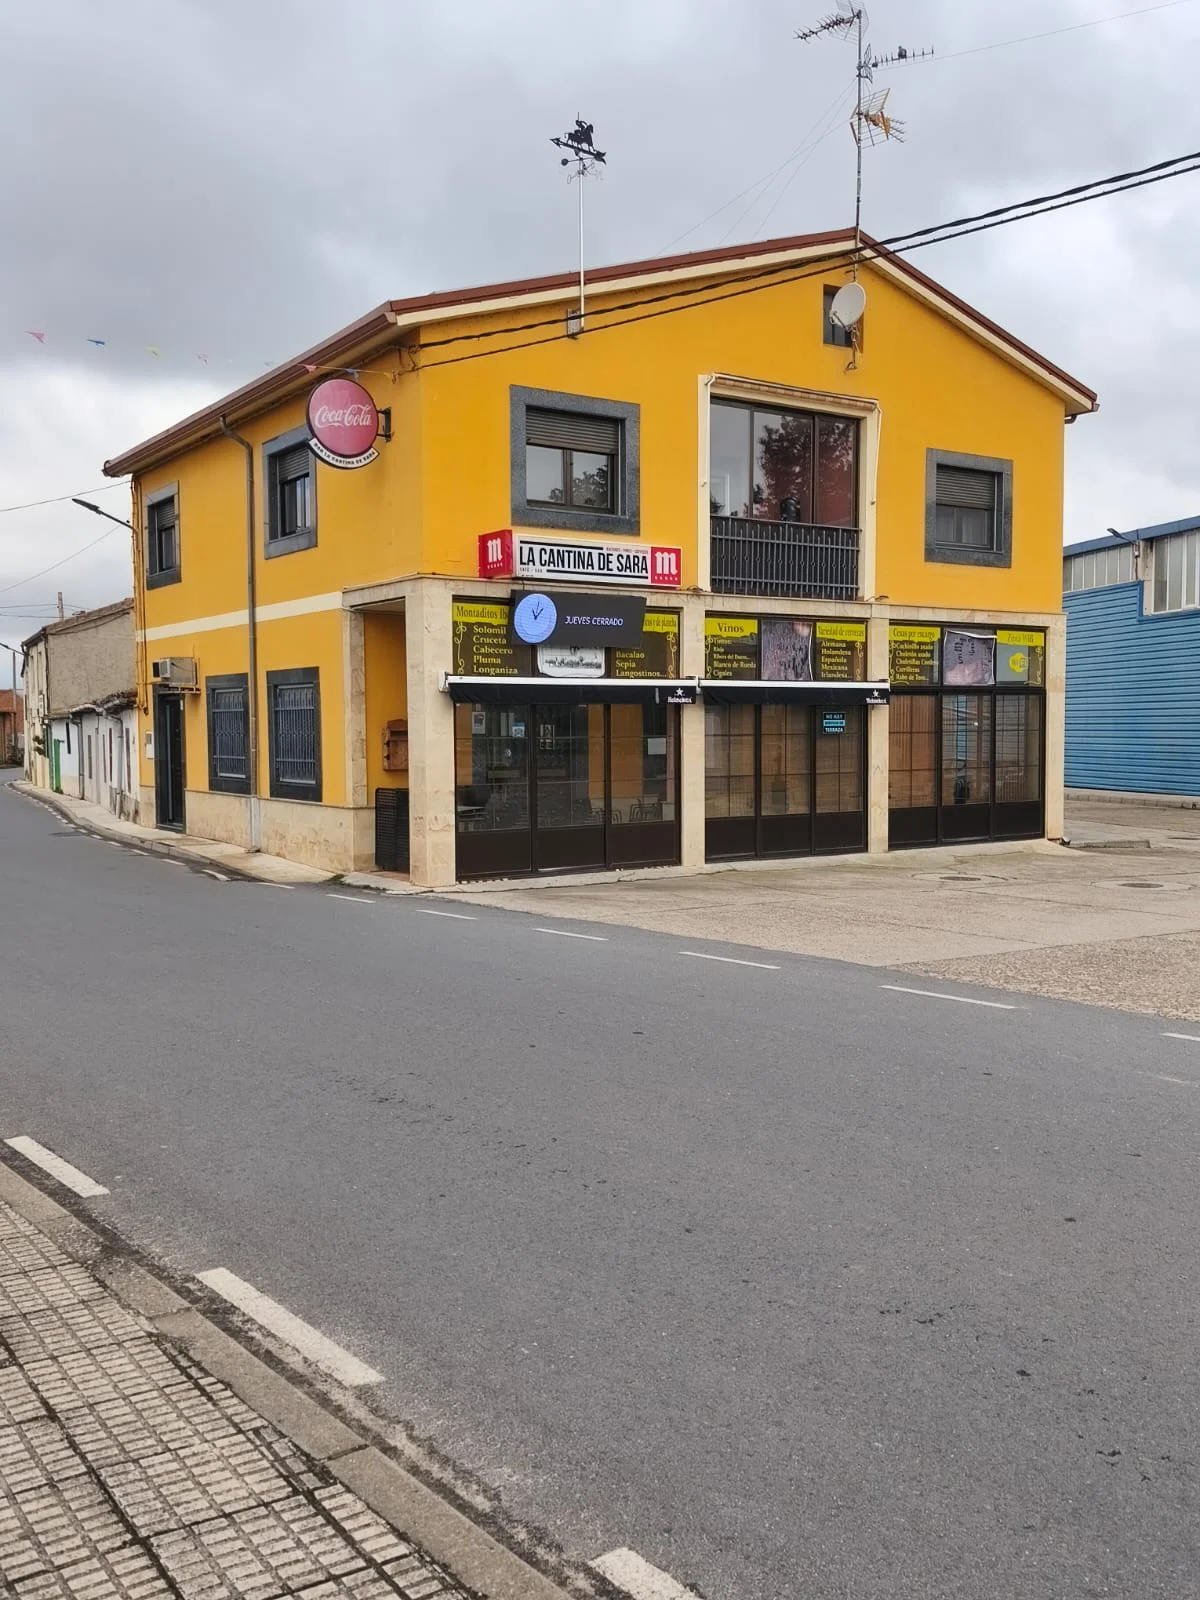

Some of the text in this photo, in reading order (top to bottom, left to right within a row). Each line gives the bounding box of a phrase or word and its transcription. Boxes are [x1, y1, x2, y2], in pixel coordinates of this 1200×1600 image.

[315, 404, 372, 428] Coca-Cola
[314, 442, 324, 453] BAR
[331, 456, 355, 465] CANTINA
[363, 450, 376, 461] SARA
[520, 546, 648, 574] LA CANTINA DE SARA
[456, 605, 498, 619] Montaditos
[565, 616, 624, 626] JUEVES CERRADO
[473, 625, 507, 634] Solomil
[717, 622, 744, 633] Vinos
[473, 635, 507, 644] Cruceta
[473, 645, 513, 654] Cabecero
[473, 655, 501, 664] Pluma
[616, 651, 645, 659] Bacalao
[616, 660, 636, 669] Sepia
[473, 665, 518, 676] Longaniza
